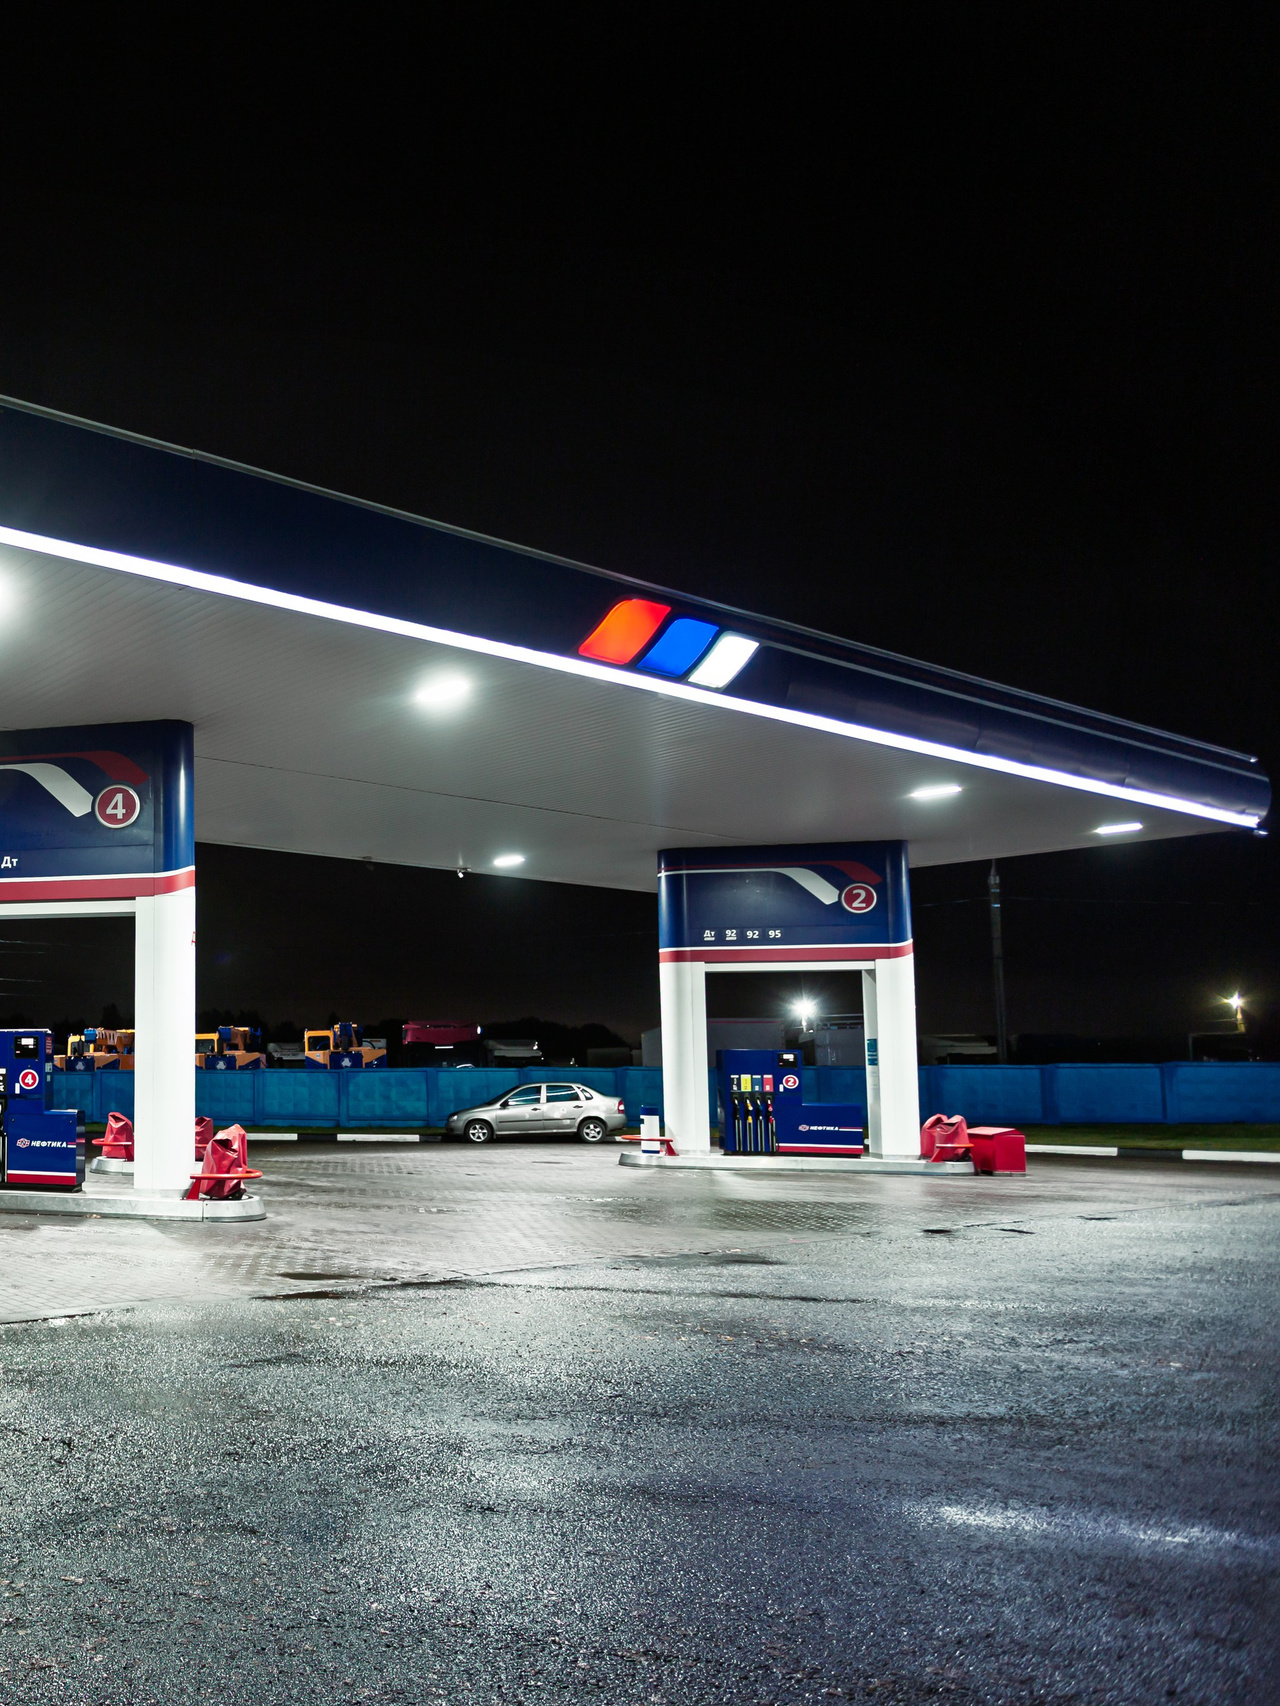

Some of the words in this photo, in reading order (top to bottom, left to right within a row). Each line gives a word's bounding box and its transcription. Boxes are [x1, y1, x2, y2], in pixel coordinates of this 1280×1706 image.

[105, 793, 126, 819] 4
[1, 856, 18, 869] Дт
[852, 889, 867, 907] 2
[725, 929, 737, 937] 92
[746, 930, 760, 939] 92
[768, 930, 782, 938] 95
[30, 1140, 67, 1148] НЕФТИКА
